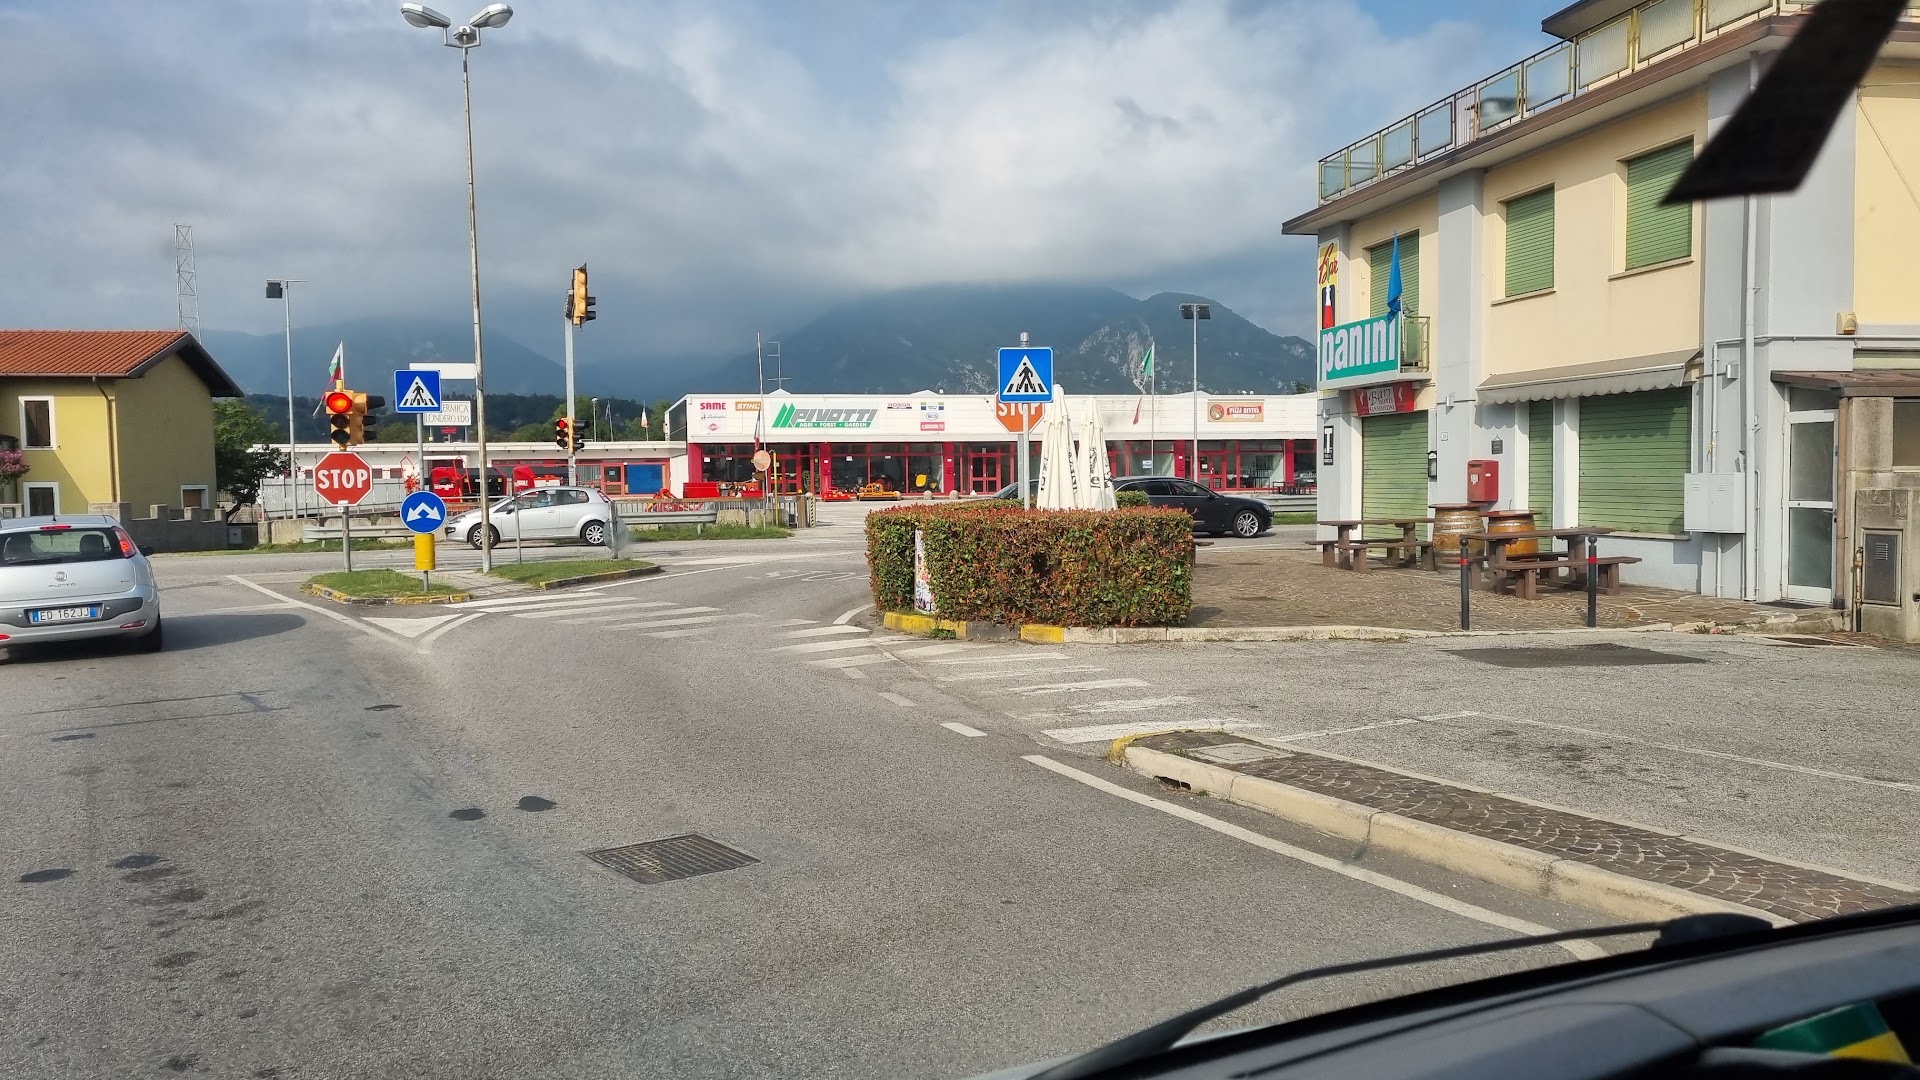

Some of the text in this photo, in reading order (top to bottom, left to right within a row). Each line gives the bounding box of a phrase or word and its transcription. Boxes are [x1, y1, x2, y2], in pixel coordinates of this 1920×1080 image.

[1321, 317, 1396, 381] panini
[443, 404, 469, 413] ERMICA
[700, 402, 726, 410] SAME
[426, 414, 456, 422] LONDERO
[794, 408, 879, 422] PIVOTTI
[317, 468, 369, 490] STOP
